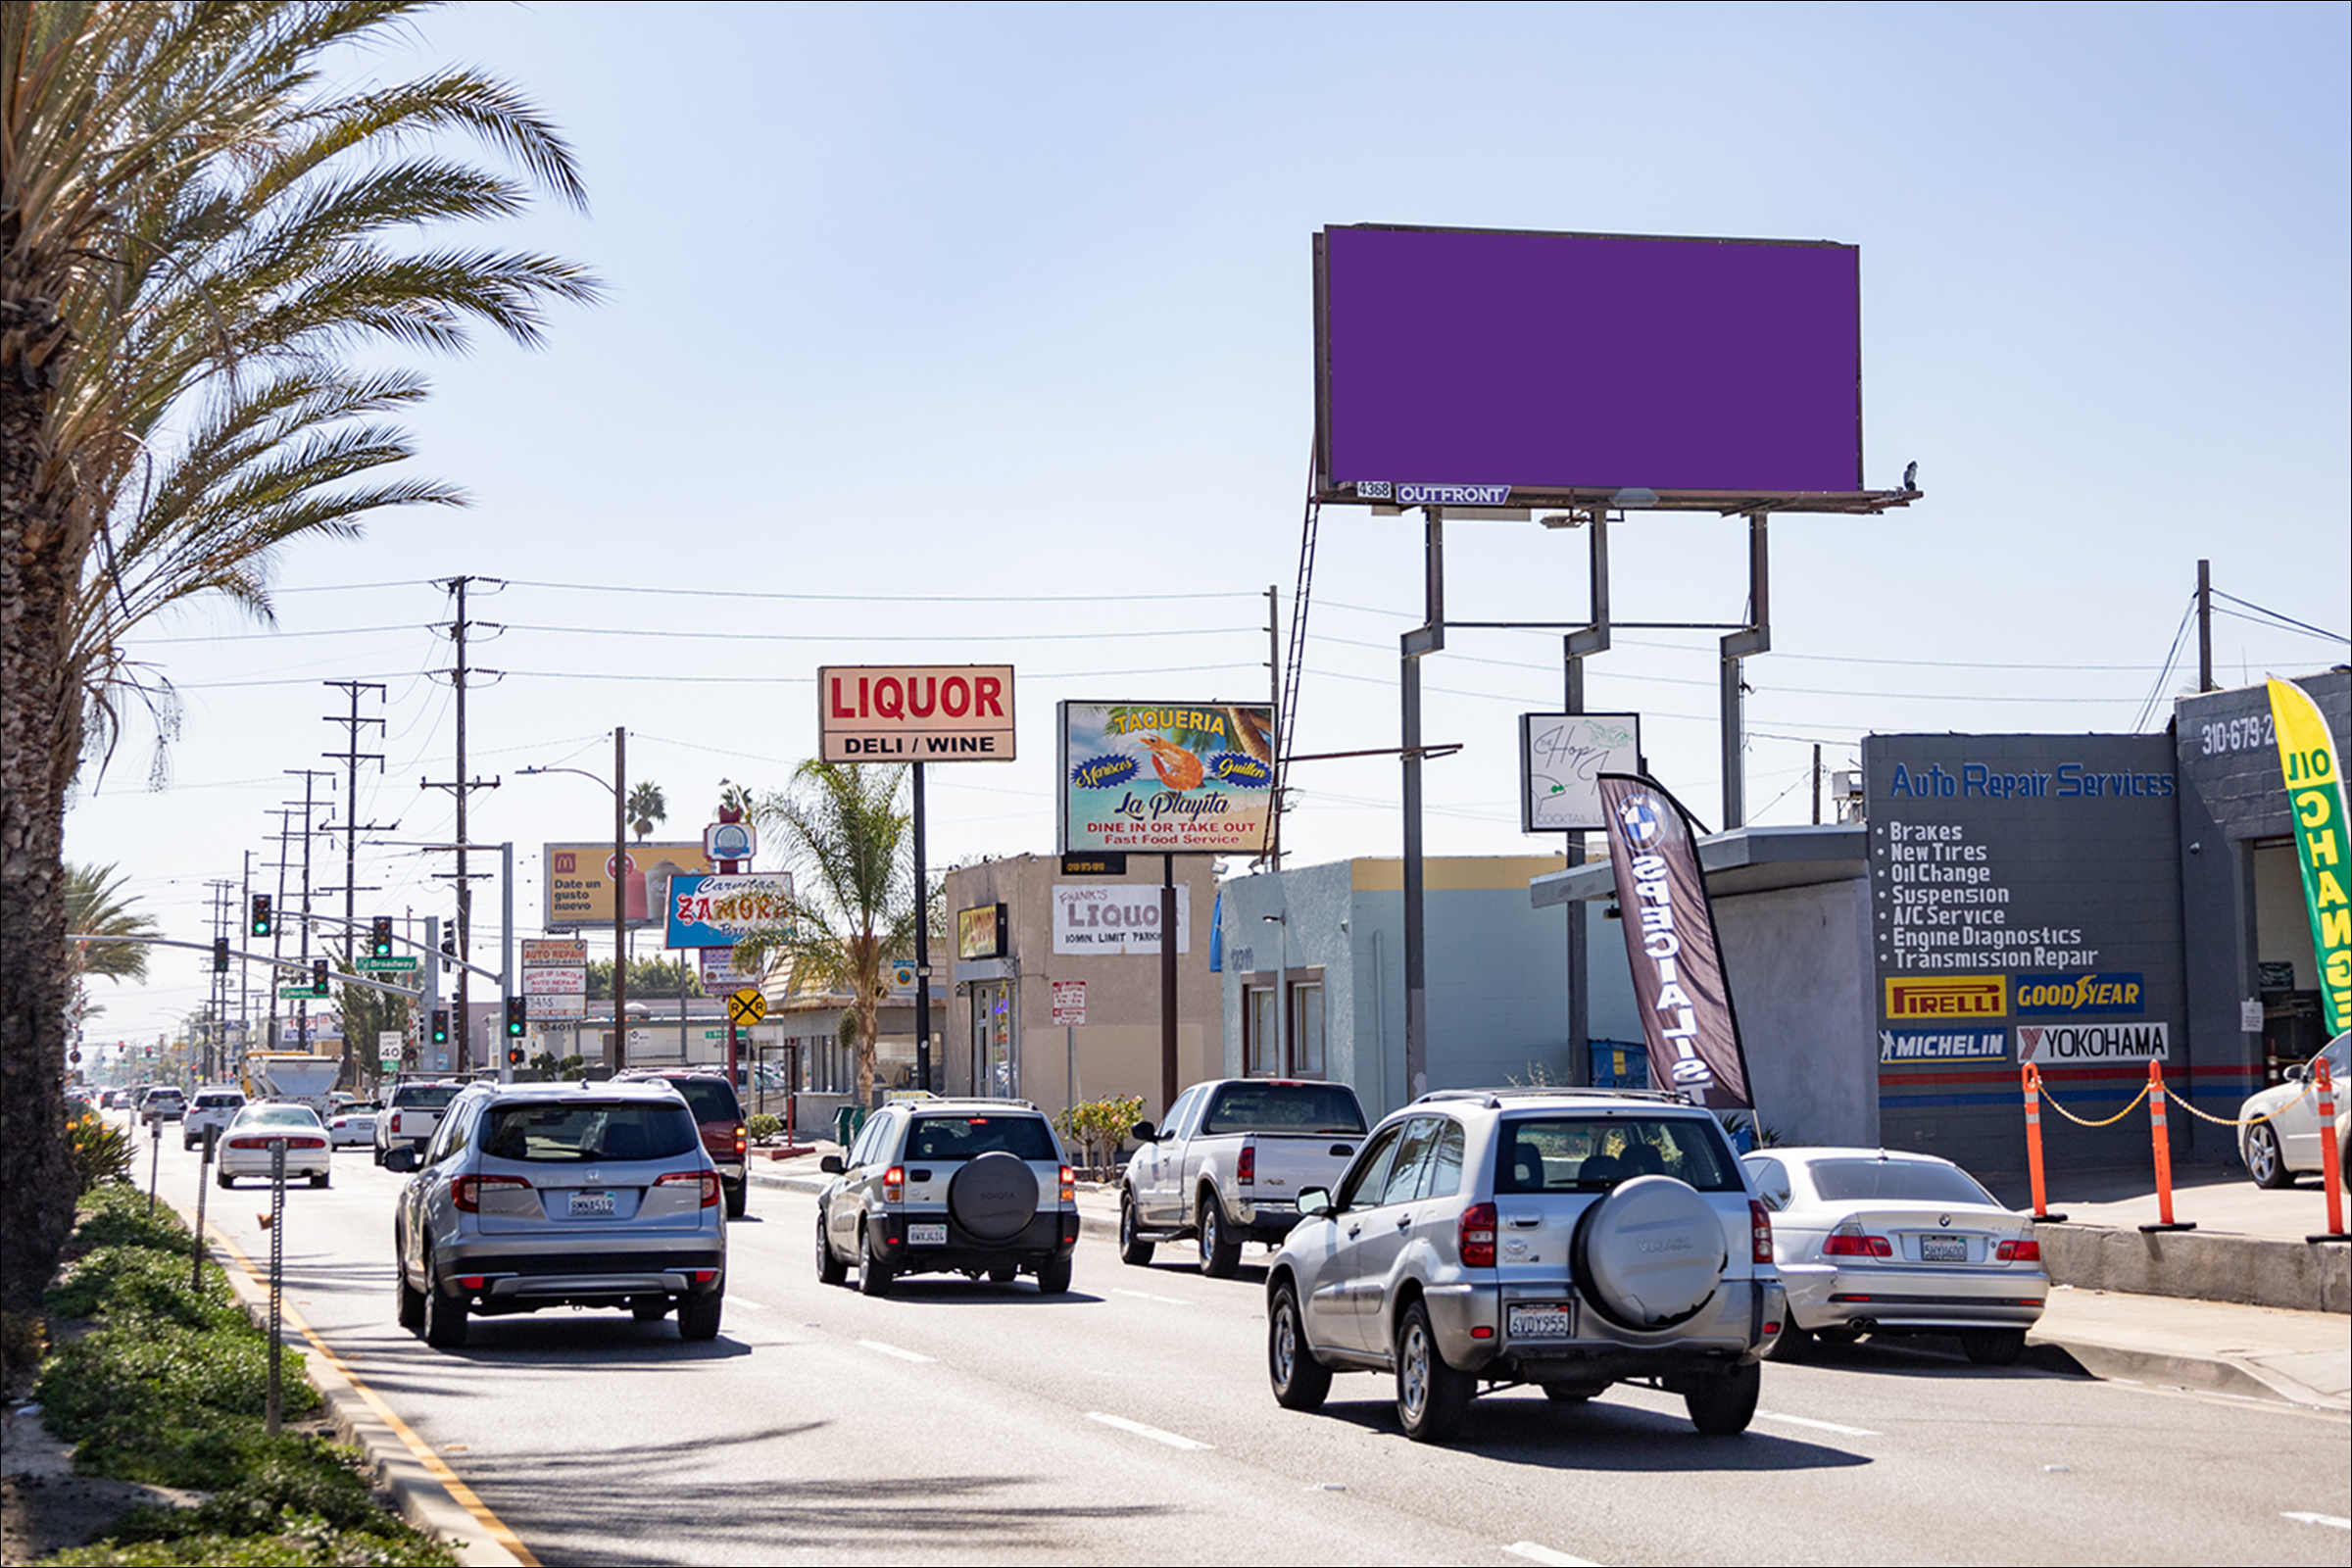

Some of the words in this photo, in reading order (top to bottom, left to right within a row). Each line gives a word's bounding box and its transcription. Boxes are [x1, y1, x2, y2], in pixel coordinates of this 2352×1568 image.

[1359, 482, 1390, 497] 4368
[1400, 487, 1504, 503] OUTFRONT
[831, 676, 1004, 721] LIQUOR
[1113, 710, 1225, 736] TAQUERIA
[845, 738, 903, 754] DELI
[926, 737, 995, 753] WINE
[1076, 758, 1132, 787] Mariscos
[1217, 758, 1266, 778] Guillen
[1889, 762, 1956, 798] Auto
[1963, 762, 2051, 800] Repair
[2056, 762, 2175, 798] Services
[1114, 791, 1145, 820] La
[1150, 791, 1230, 821] Playita
[1087, 822, 1125, 833] DINE
[1130, 822, 1147, 833] IN
[1151, 822, 1174, 833] OR
[1178, 822, 1219, 833] TAKE
[1223, 822, 1256, 833] OUT
[1536, 813, 1590, 824] COCKTAIL
[1104, 835, 1137, 845] Fast
[1142, 835, 1178, 845] Food
[1183, 835, 1240, 845] Service
[1889, 821, 1963, 842] Brakes
[1890, 844, 1928, 861] New
[1933, 844, 1987, 861] Tires
[555, 879, 583, 889] Date
[1891, 864, 1915, 883] Oil
[1918, 864, 1990, 885] Change
[554, 891, 590, 902] gusto
[1059, 889, 1107, 905] FRANK'S
[1892, 886, 2009, 906] Suspension
[1068, 904, 1180, 928] LIQUO
[1893, 906, 1924, 925] A/C
[1927, 906, 2005, 925] Service
[1099, 933, 1126, 943] LIMIT
[1893, 927, 1959, 951] Engine
[1963, 926, 2082, 949] Diagnostics
[370, 959, 415, 968] Broadway
[1894, 949, 2032, 969] Transmission
[2034, 947, 2098, 970] Repair
[1893, 984, 2000, 1014] PIRELLI
[2018, 979, 2138, 1008] GOODYEAR
[731, 1003, 740, 1011] R
[755, 1002, 763, 1011] R
[1895, 1034, 2004, 1056] MICHELIN
[2045, 1027, 2166, 1057] YOKOHAMA
[381, 1048, 400, 1057] 40
[1512, 1315, 1566, 1333] 6VDY955
